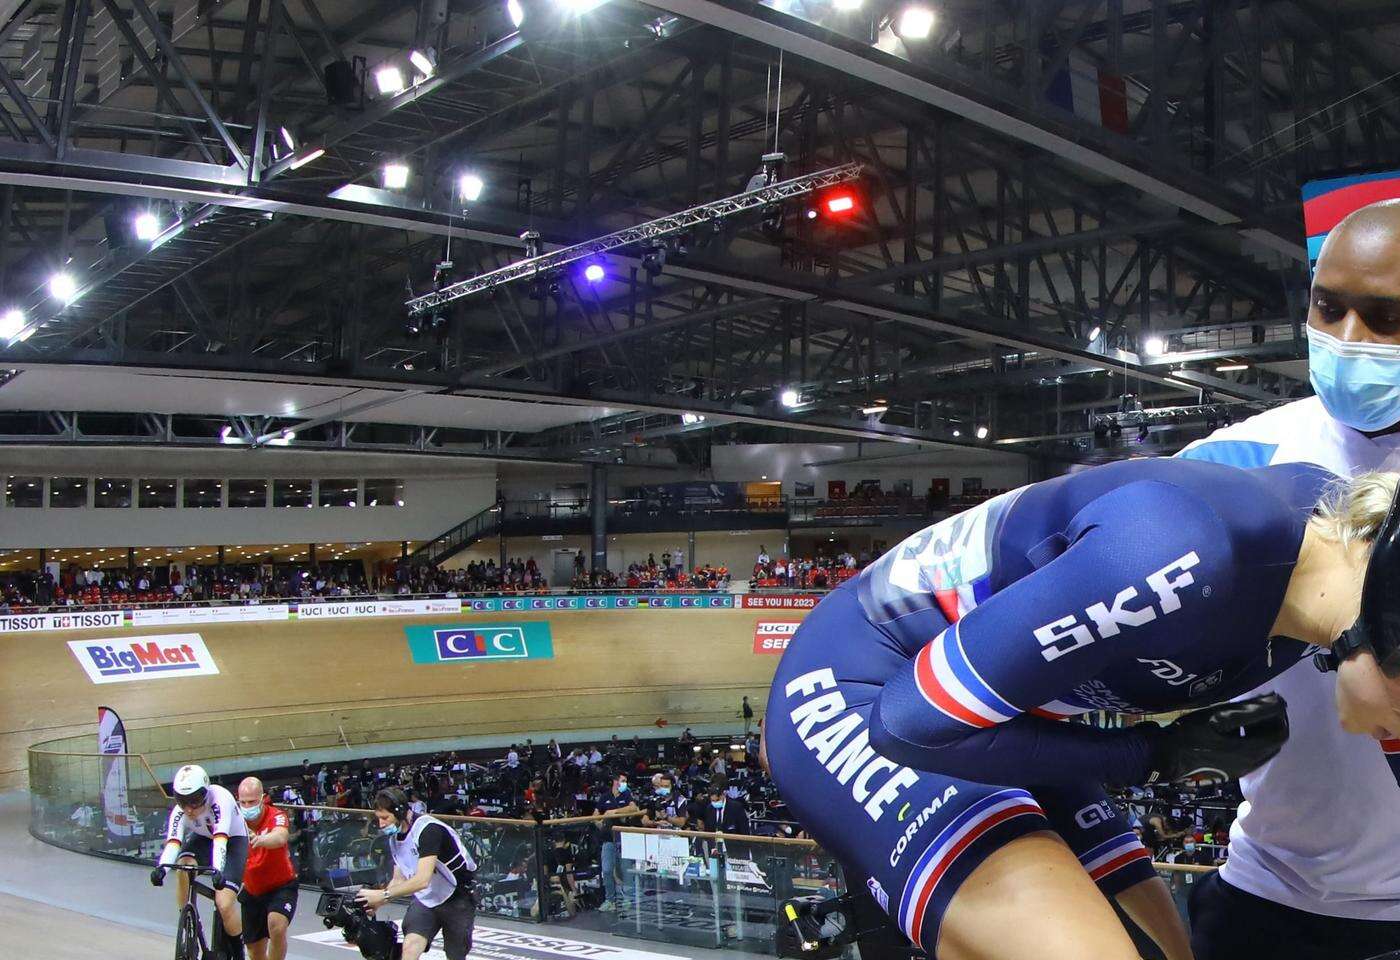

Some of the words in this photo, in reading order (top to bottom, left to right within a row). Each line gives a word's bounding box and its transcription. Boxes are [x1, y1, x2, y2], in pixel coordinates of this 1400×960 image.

[747, 598, 764, 607] SEE
[765, 598, 782, 607] YOU
[783, 598, 792, 607] IN
[793, 598, 814, 607] 2023
[1032, 551, 1201, 663] SKF
[72, 613, 120, 628] TISSOT
[86, 642, 197, 674] BigMat
[1136, 657, 1198, 686] FDJ
[785, 667, 920, 823] FRANCE
[889, 784, 959, 868] CORIMA
